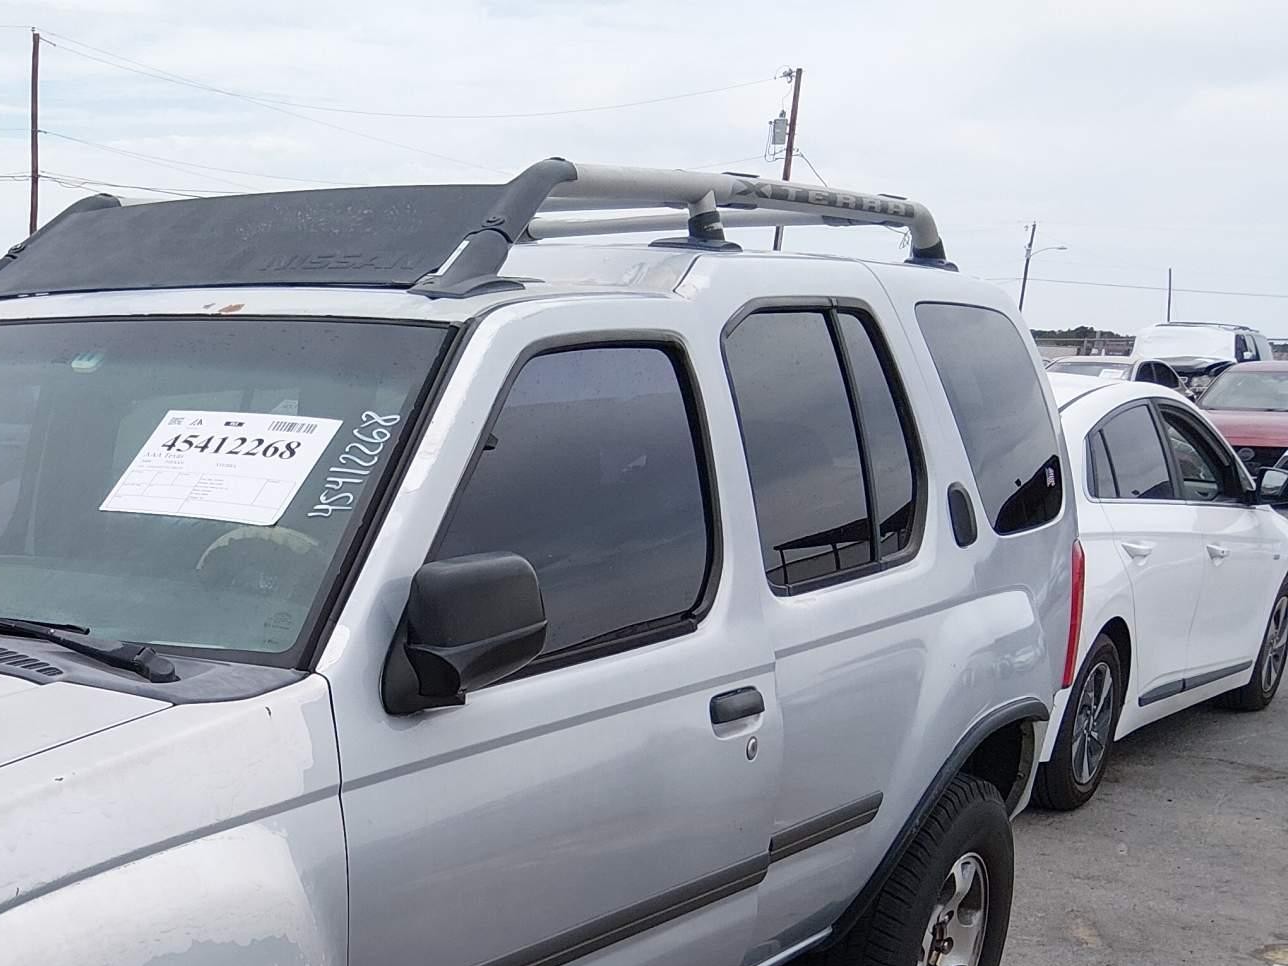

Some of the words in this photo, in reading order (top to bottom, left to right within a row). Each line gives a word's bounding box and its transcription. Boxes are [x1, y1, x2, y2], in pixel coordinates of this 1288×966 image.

[732, 179, 910, 217] XTERRA
[258, 254, 420, 272] NISSAN
[162, 433, 302, 460] 45412268
[307, 411, 400, 517] 45412268
